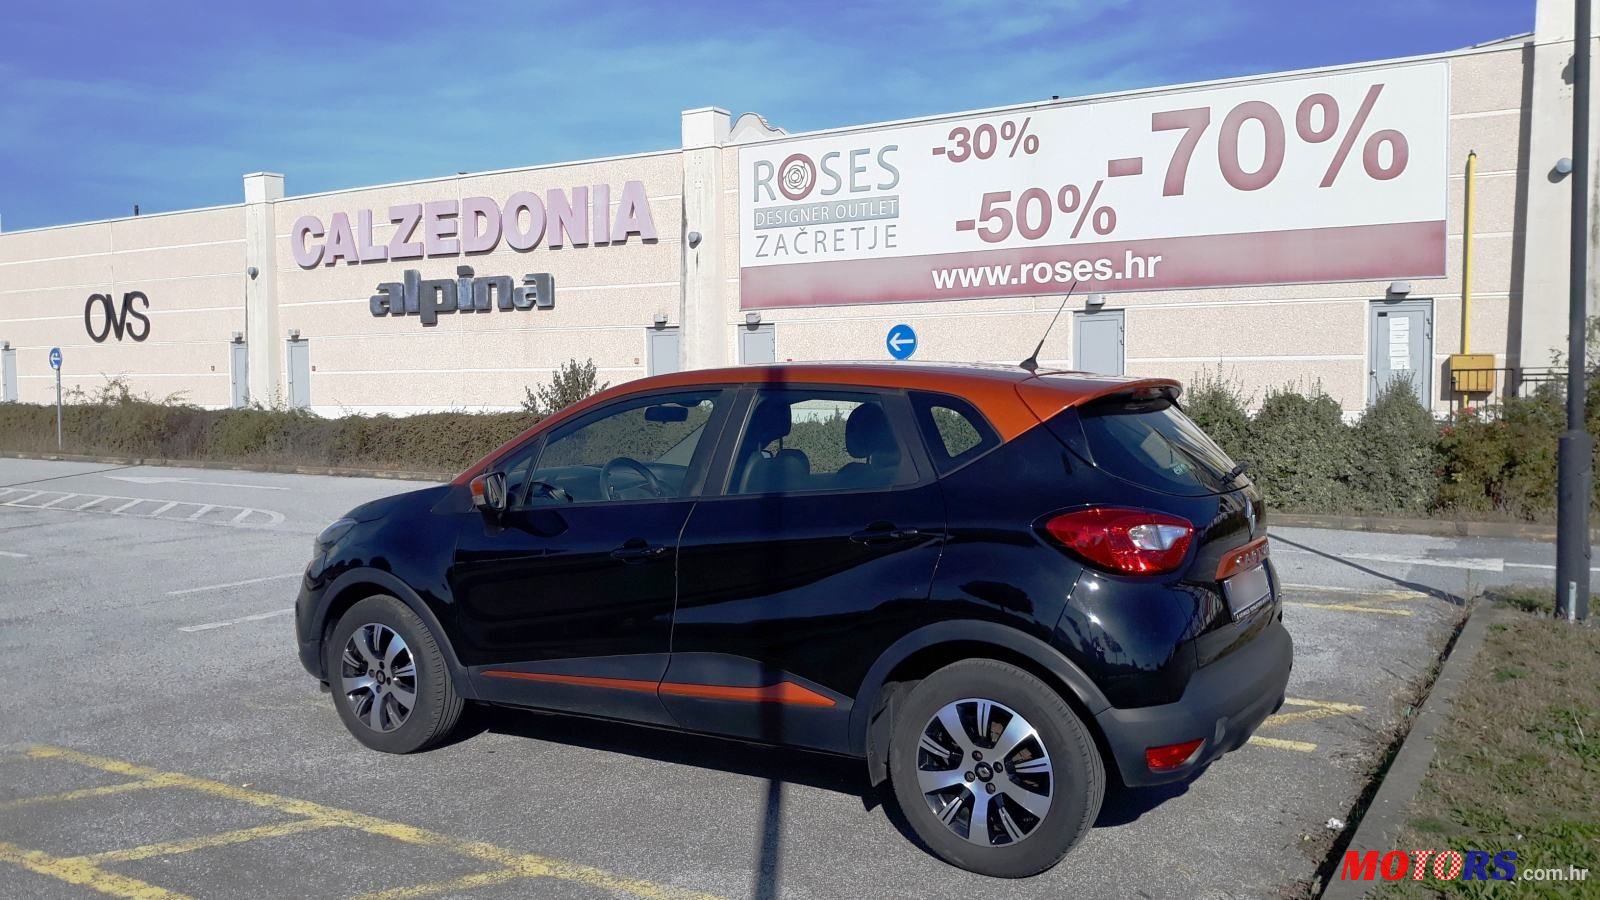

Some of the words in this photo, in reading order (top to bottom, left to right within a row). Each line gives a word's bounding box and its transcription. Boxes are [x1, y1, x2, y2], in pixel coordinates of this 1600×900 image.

[931, 117, 1040, 163] -30%
[1108, 84, 1409, 197] -70%
[753, 145, 900, 202] ROSES
[292, 180, 657, 268] CALZEDONIA
[755, 205, 829, 226] DESIGNER
[835, 199, 898, 217] OUTLET
[955, 180, 1117, 243] -50%
[755, 224, 898, 257] ZAČRETJE
[370, 266, 555, 326] alpina
[932, 250, 1162, 289] www.roses.hr
[84, 291, 151, 342] OVS
